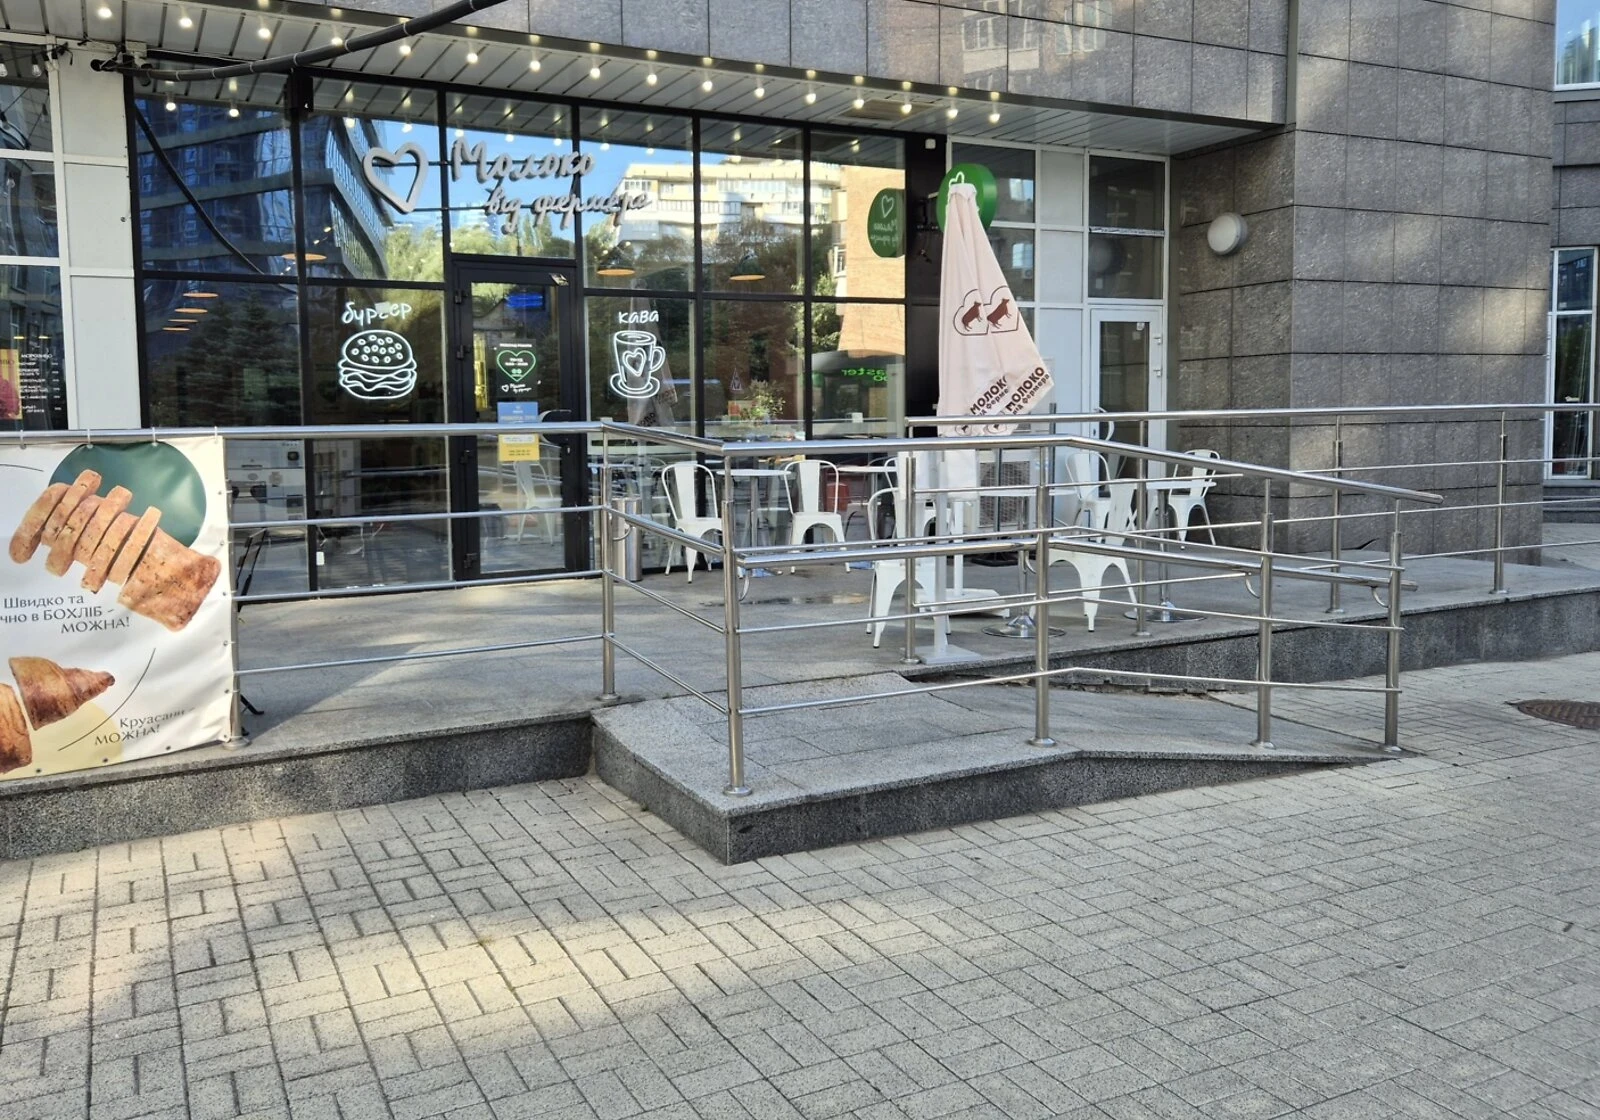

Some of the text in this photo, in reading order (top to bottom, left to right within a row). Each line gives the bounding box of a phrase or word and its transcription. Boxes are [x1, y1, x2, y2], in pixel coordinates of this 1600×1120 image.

[451, 137, 596, 184] Молоко
[487, 186, 653, 234] від фермера
[618, 310, 659, 324] кава
[985, 388, 1009, 410] ферме
[1005, 367, 1045, 412] МОЛОКО
[1022, 374, 1050, 404] фермера
[4, 595, 84, 608] Швидко та
[31, 612, 39, 621] в
[43, 606, 102, 621] БОХЛІБ
[61, 616, 130, 634] МОЖНА!
[95, 724, 160, 745] МОЖНА!
